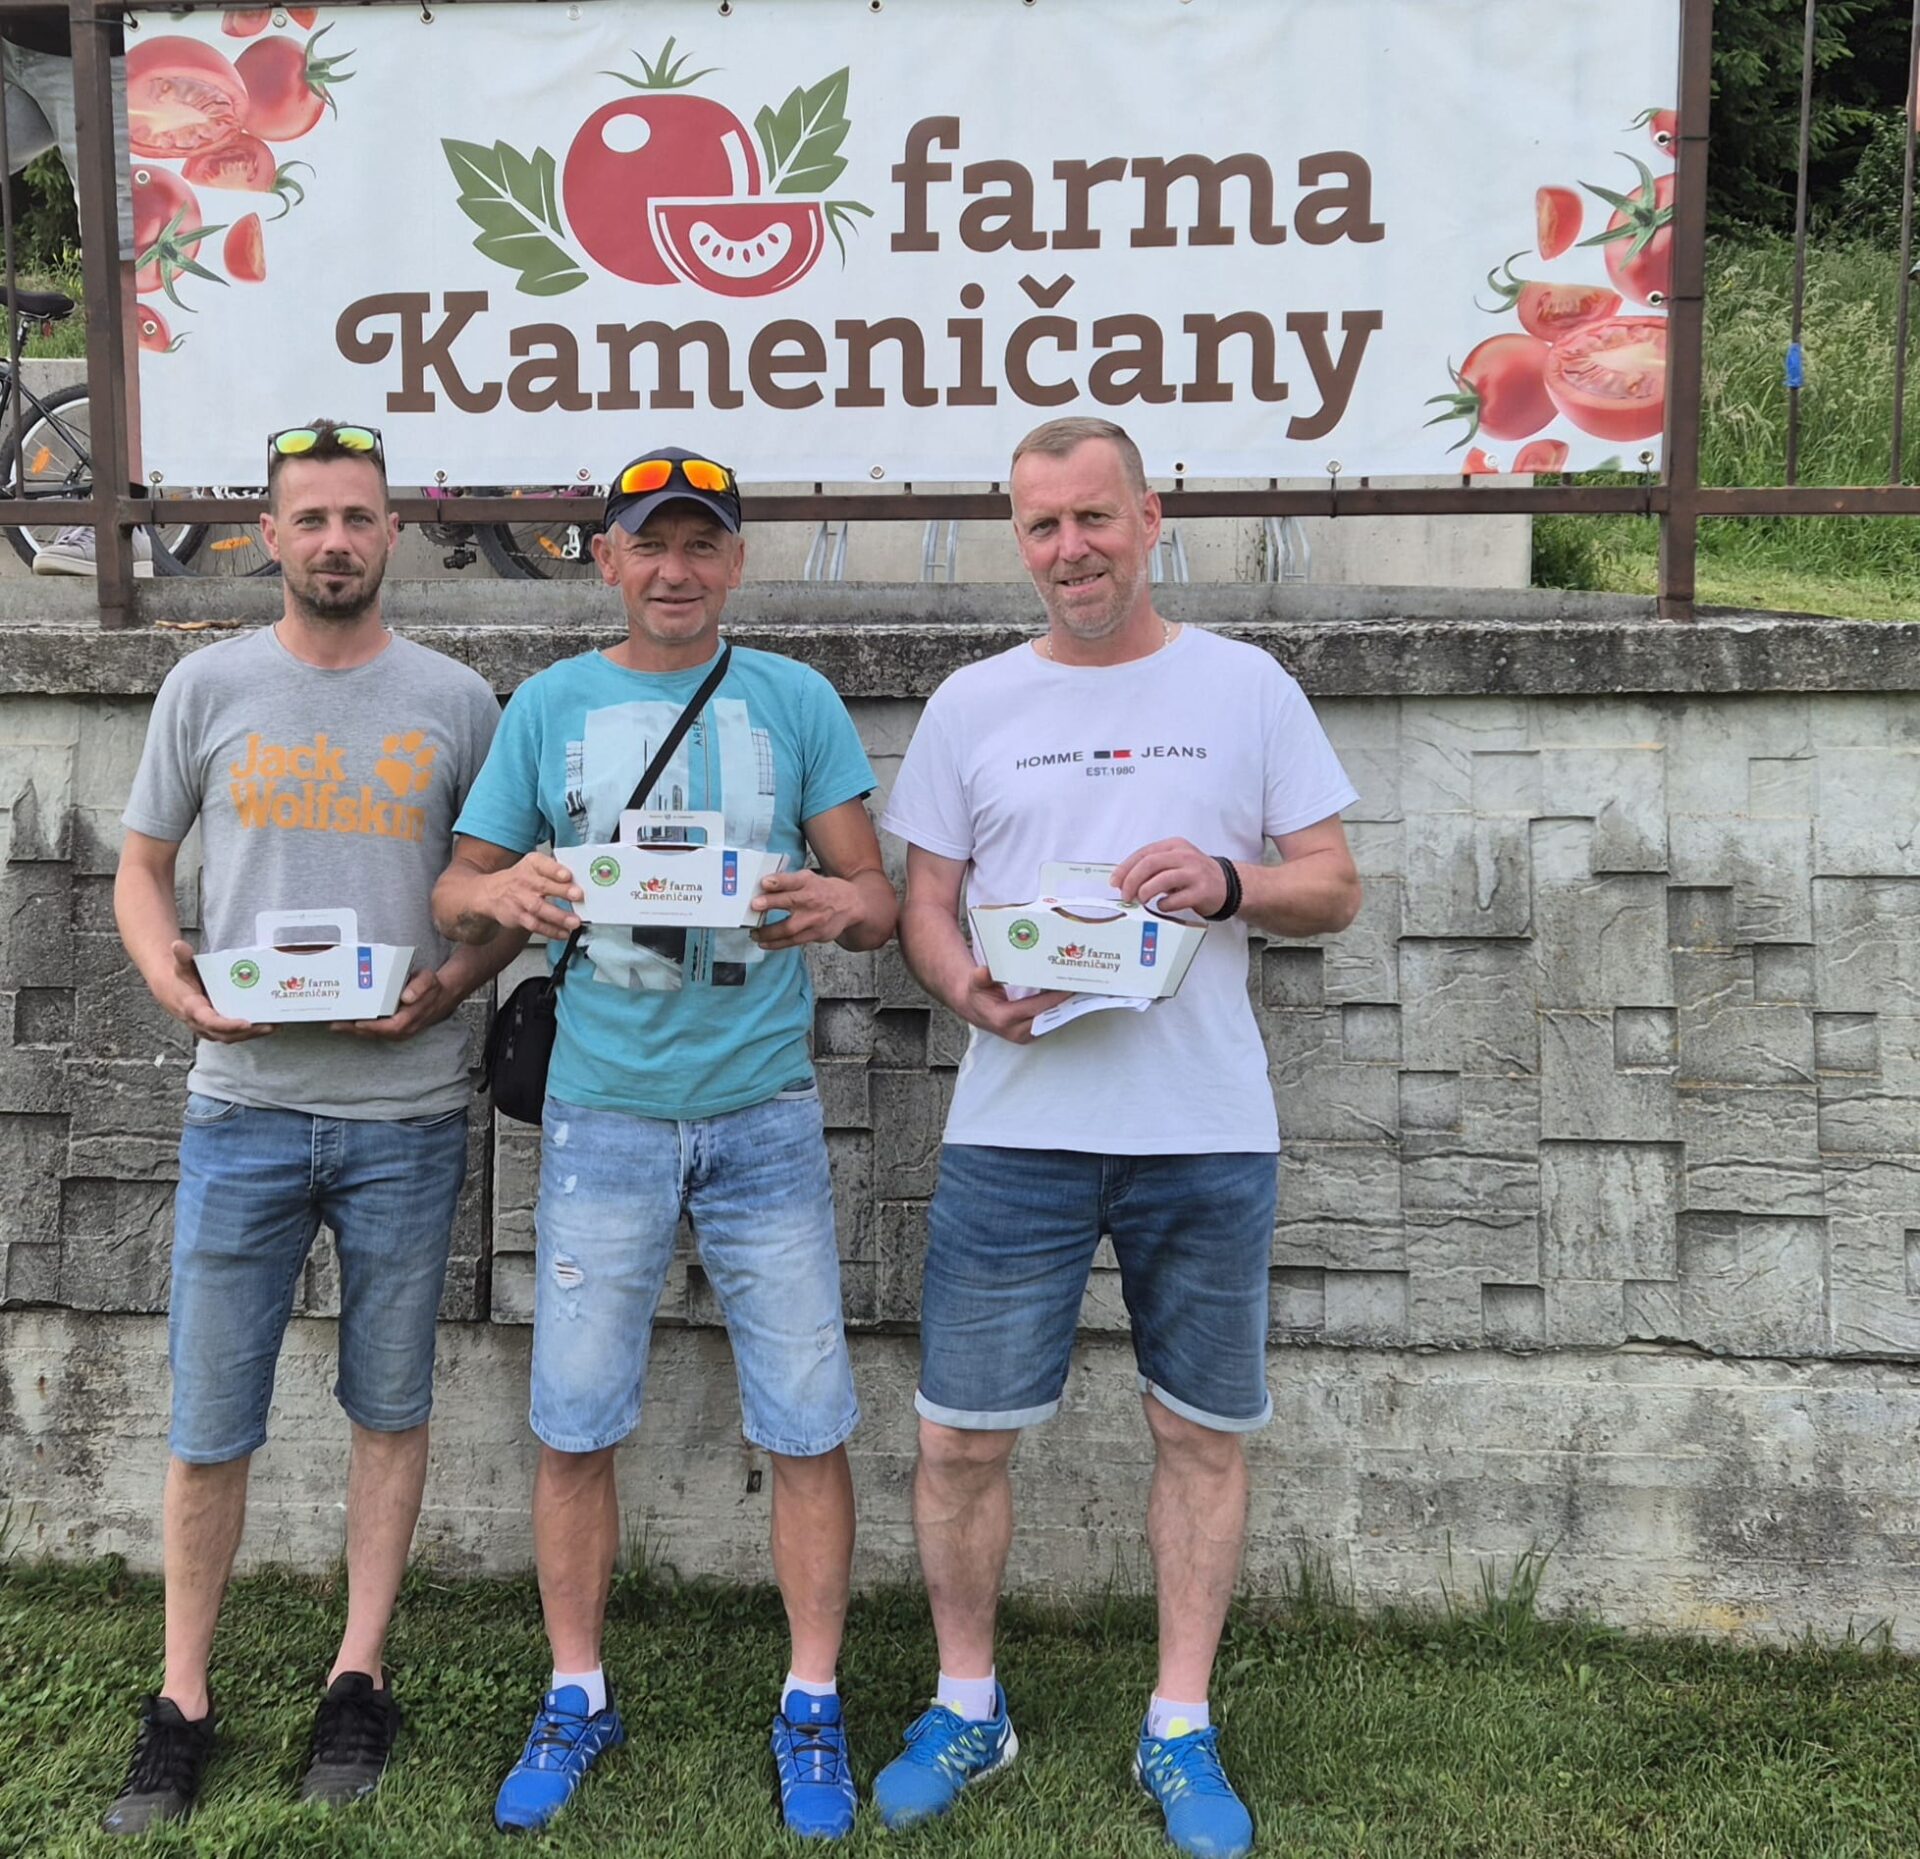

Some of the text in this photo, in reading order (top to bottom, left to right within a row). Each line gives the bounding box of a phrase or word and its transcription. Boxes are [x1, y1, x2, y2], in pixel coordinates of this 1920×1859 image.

[890, 116, 1386, 252] farma
[335, 273, 1384, 441] Kameničany
[230, 734, 346, 781] Jack
[1016, 746, 1208, 770] HOMME JEANS
[1086, 766, 1136, 777] EST.1980
[230, 782, 426, 843] Wolfskin
[669, 881, 703, 892] farma
[1087, 947, 1121, 960] farma
[308, 978, 340, 988] farma
